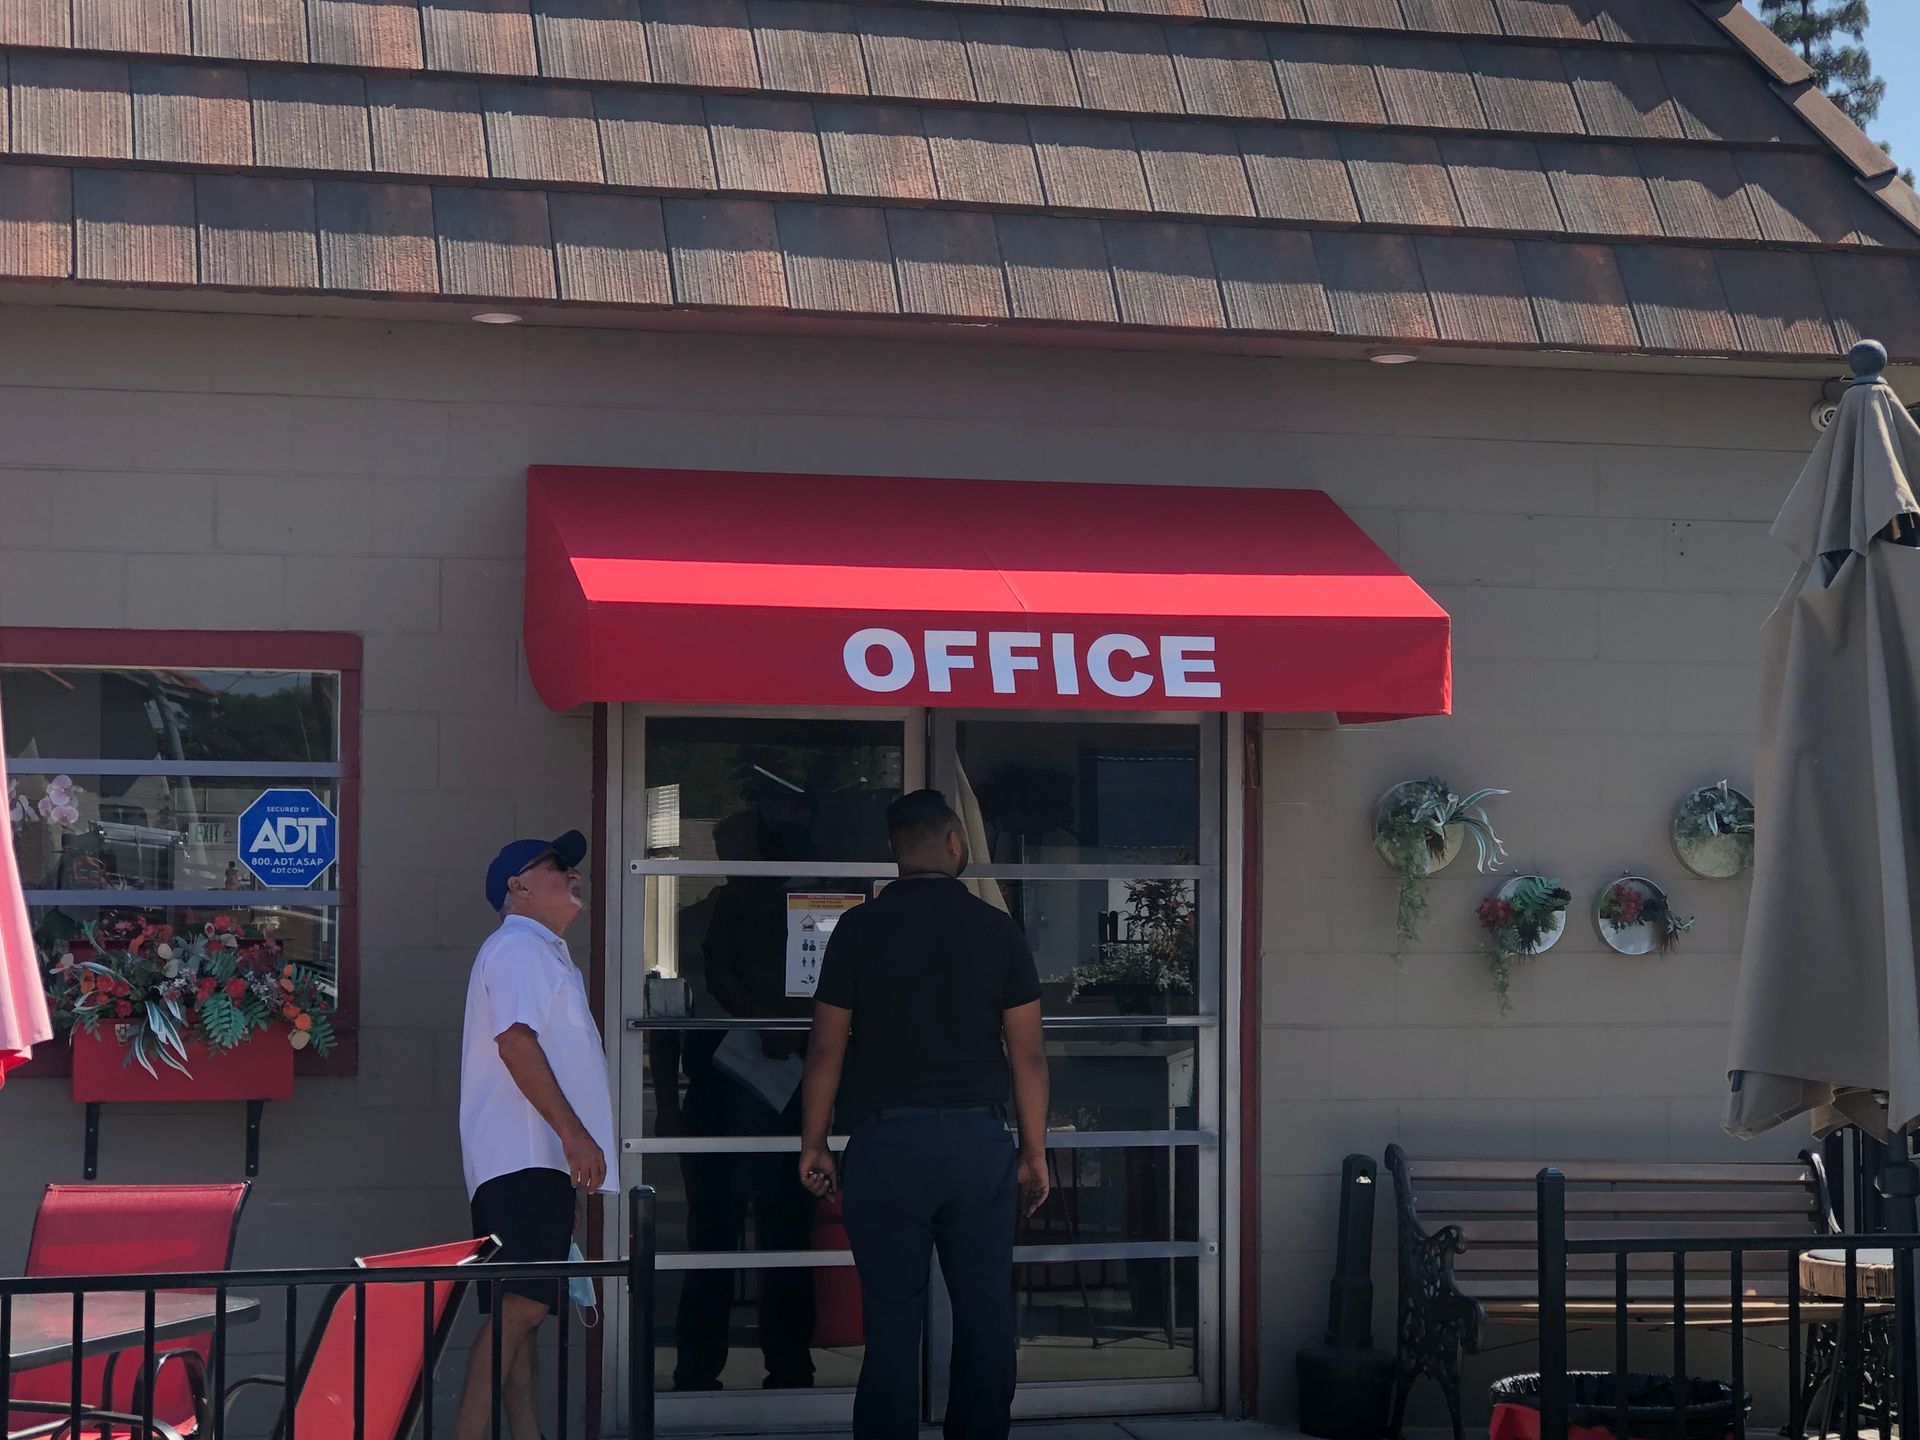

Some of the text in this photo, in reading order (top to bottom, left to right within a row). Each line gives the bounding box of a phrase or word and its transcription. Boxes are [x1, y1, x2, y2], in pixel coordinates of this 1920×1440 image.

[842, 627, 1222, 699] OFFICE
[196, 823, 220, 843] EXIT
[249, 816, 327, 853] ADT
[251, 857, 324, 866] 800.ADT.ASAP
